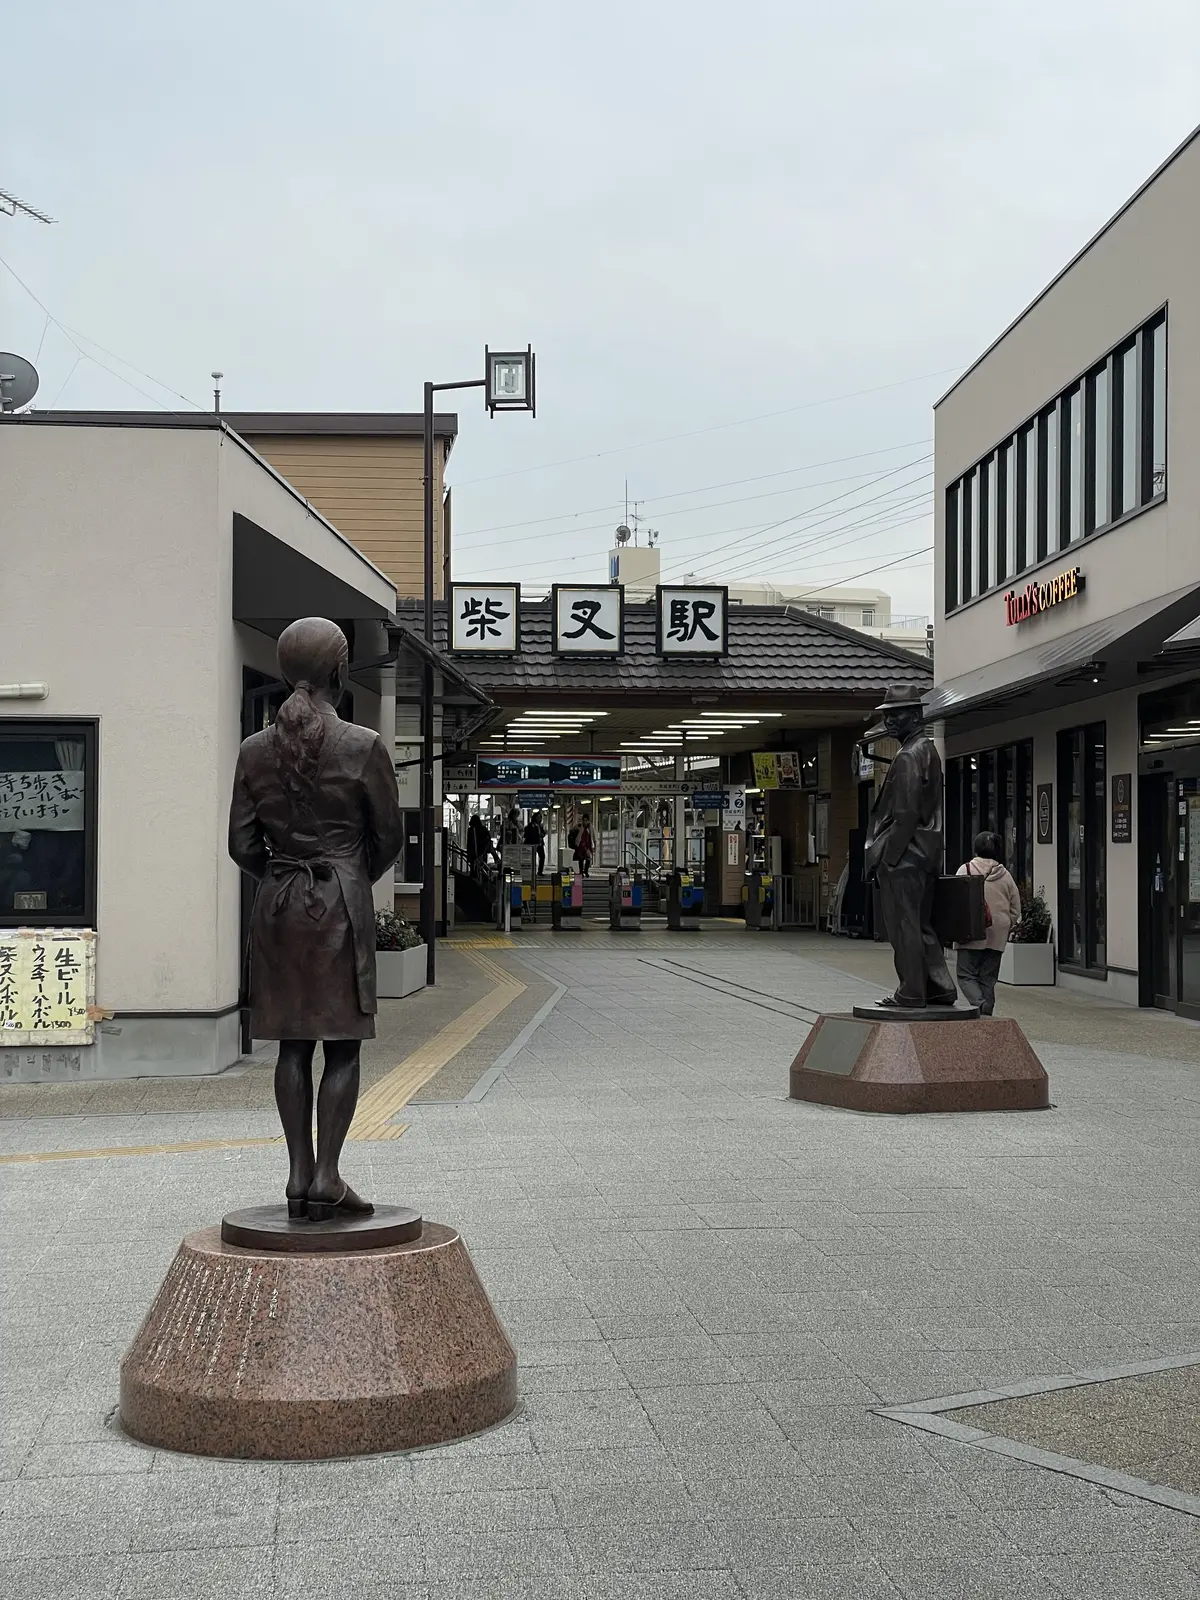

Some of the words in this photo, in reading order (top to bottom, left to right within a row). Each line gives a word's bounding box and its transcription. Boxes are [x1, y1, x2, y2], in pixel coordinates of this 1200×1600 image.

[460, 597, 720, 642] 柴又駅
[1004, 583, 1038, 627] TULLY'S
[1039, 567, 1078, 611] COFFEE
[54, 948, 81, 1004] 生ビール
